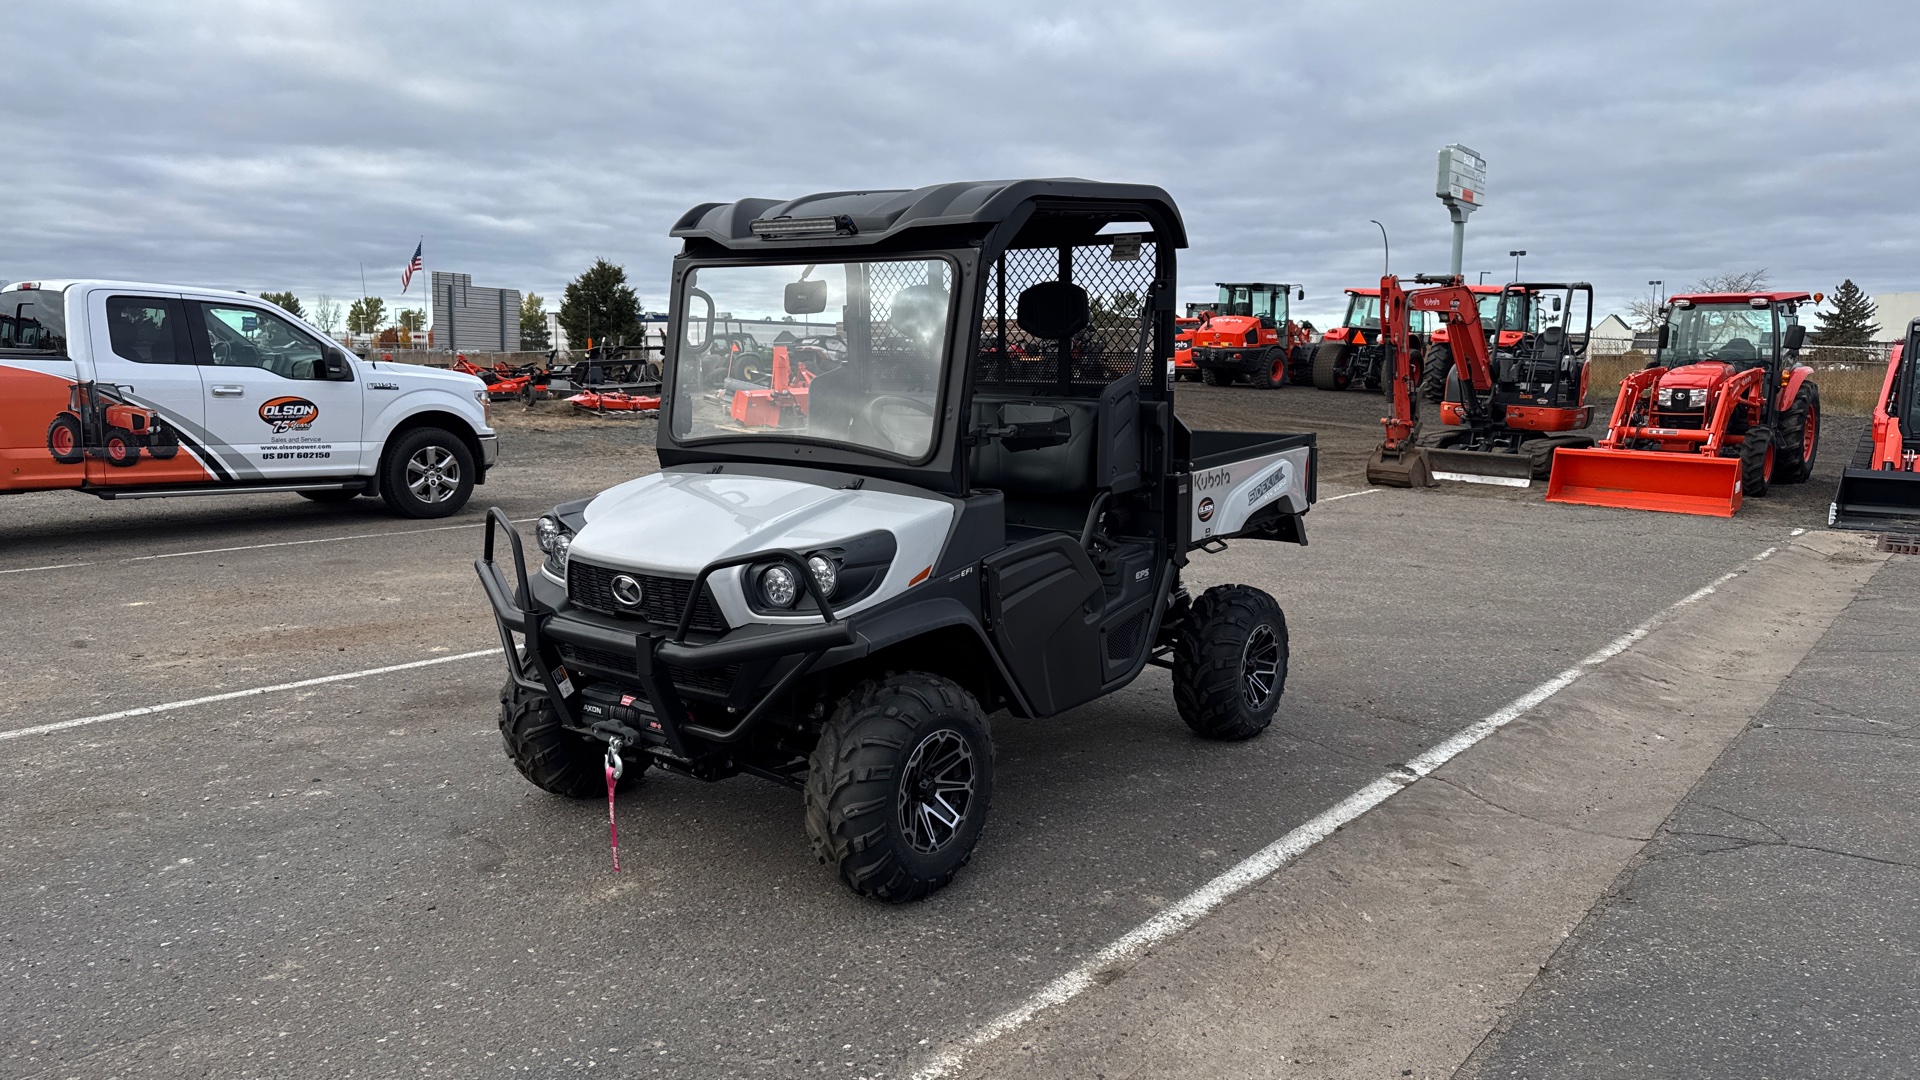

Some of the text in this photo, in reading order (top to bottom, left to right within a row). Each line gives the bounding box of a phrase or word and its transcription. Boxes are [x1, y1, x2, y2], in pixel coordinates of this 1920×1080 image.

[264, 405, 314, 416] OLSON
[273, 420, 290, 433] 75
[1194, 468, 1230, 490] Kubota
[1248, 467, 1285, 506] SIDEKICK
[1199, 504, 1214, 514] OLSON
[961, 566, 973, 577] EFI
[1135, 568, 1149, 580] EPS
[583, 704, 602, 715] AXON
